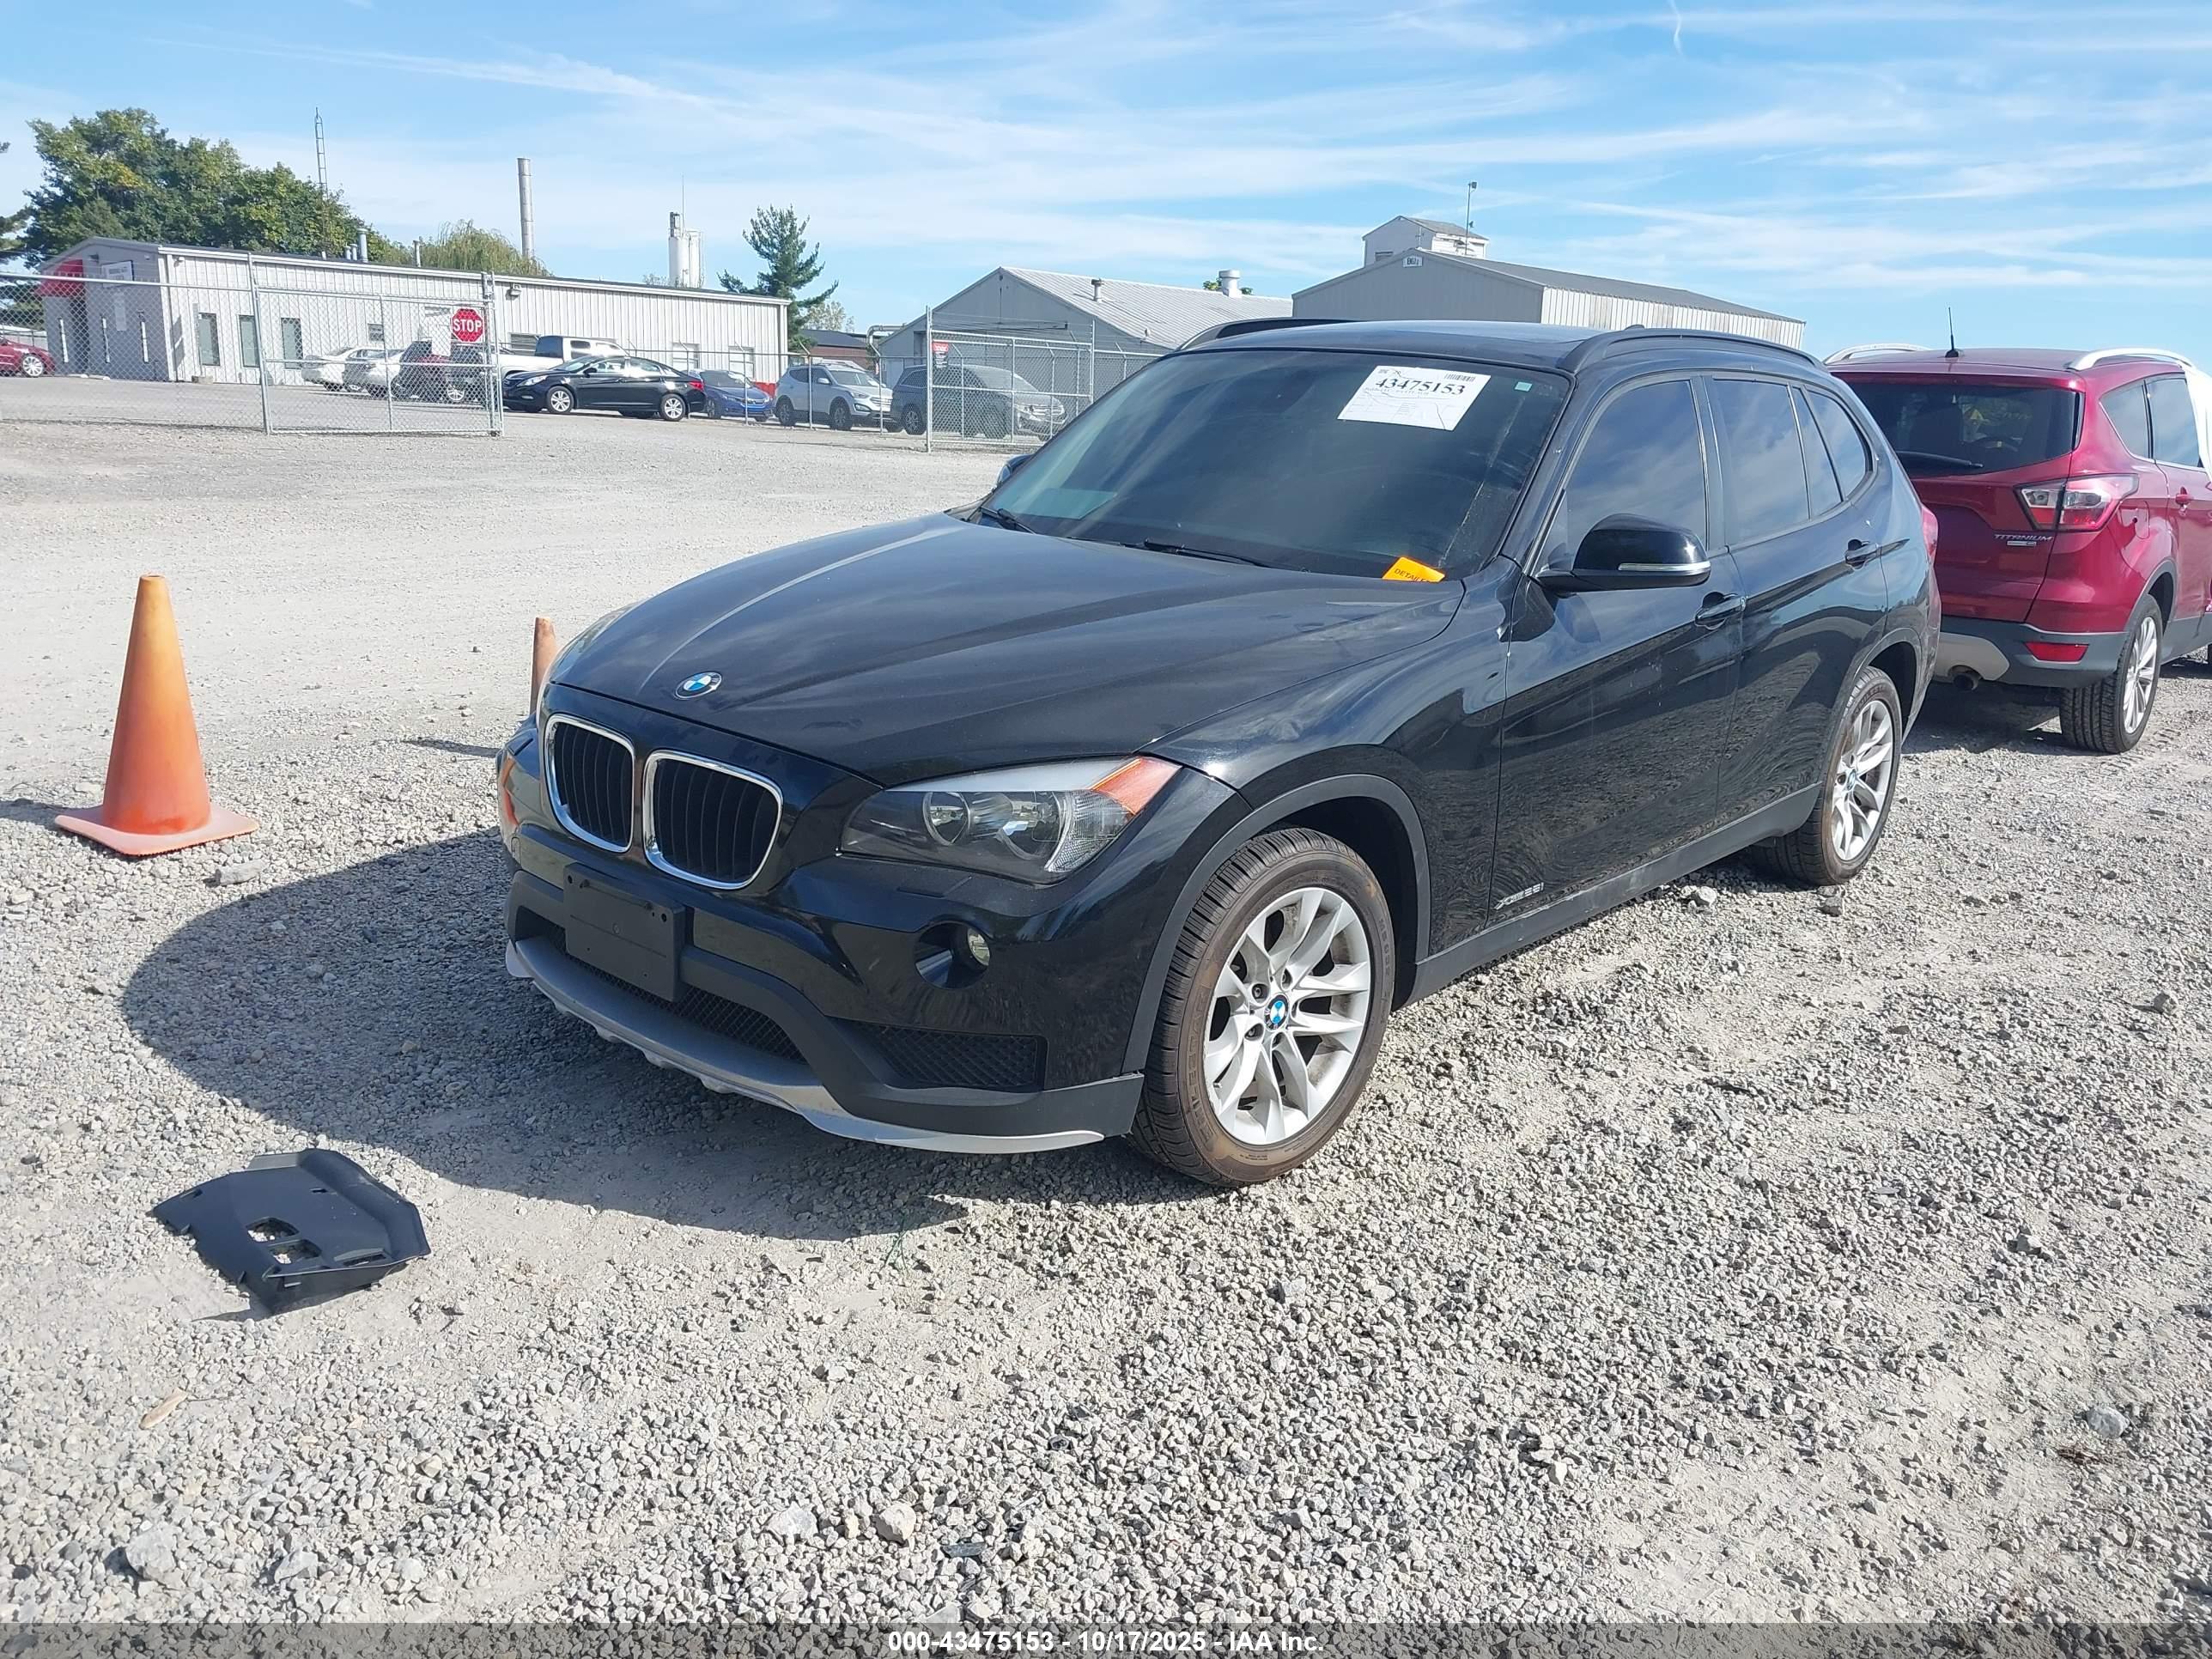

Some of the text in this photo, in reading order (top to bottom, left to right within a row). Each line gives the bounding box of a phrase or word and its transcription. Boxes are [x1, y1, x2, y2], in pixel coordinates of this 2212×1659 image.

[453, 318, 483, 333] STOP
[1376, 378, 1466, 396] 43475153
[1994, 533, 2055, 542] TITANIUM
